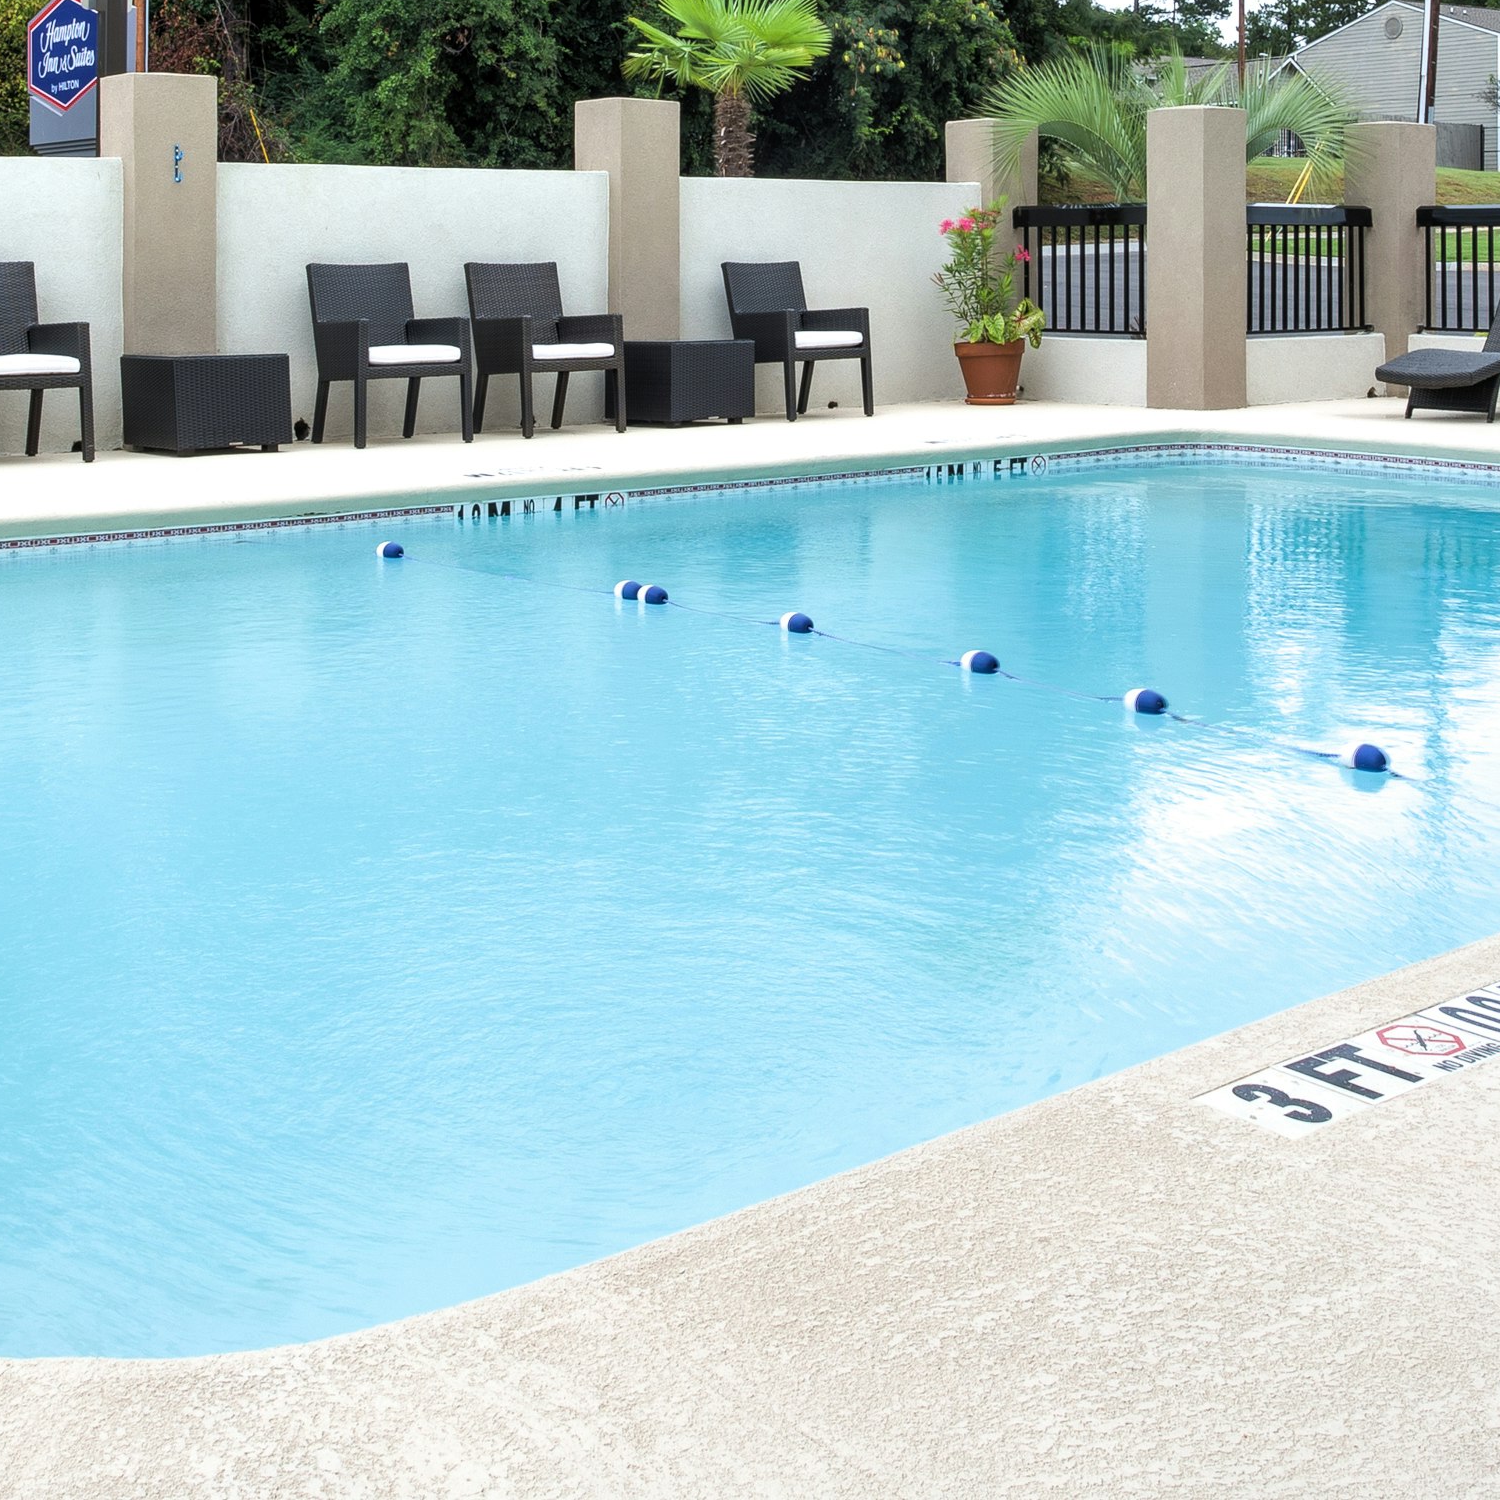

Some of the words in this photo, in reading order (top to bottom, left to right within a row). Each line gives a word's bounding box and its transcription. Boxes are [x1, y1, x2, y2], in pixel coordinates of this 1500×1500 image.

[40, 18, 90, 52] Hampton
[38, 52, 62, 79] Inn
[67, 45, 95, 71] Suites
[51, 83, 58, 95] by
[58, 79, 80, 92] HILTON
[1432, 1059, 1464, 1072] NO
[1232, 1083, 1333, 1123] 3
[1289, 1043, 1424, 1100] FT
